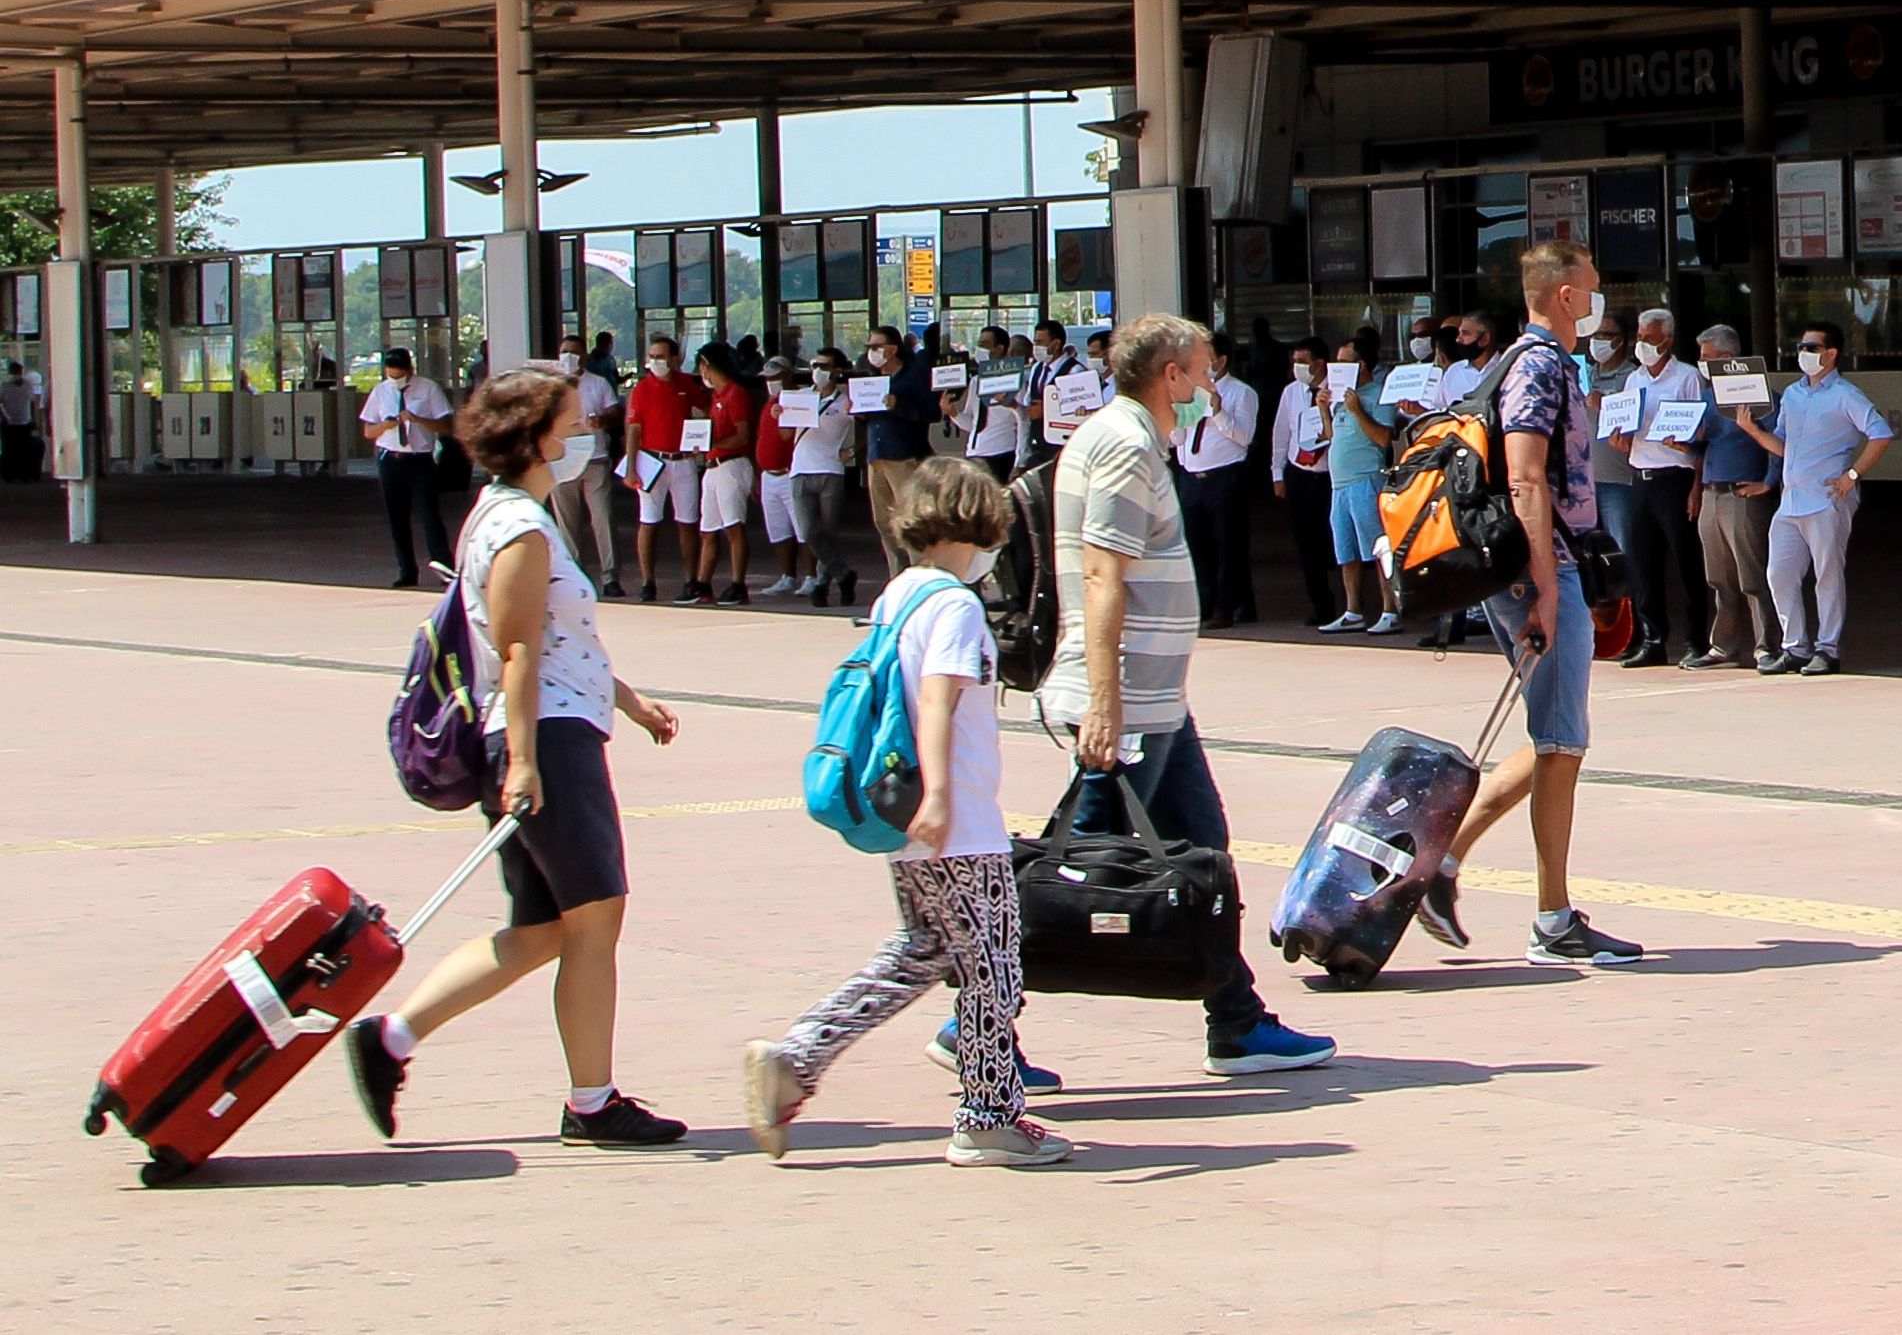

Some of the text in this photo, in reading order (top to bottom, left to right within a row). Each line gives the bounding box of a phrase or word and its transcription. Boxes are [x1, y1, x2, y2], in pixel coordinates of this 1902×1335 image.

[1577, 36, 1820, 104] BURGER KNG
[1600, 207, 1657, 227] FISCHER
[1604, 397, 1637, 412] VIOLETTA
[1606, 413, 1630, 427] LEVINA
[1655, 423, 1692, 433] KRASNOV
